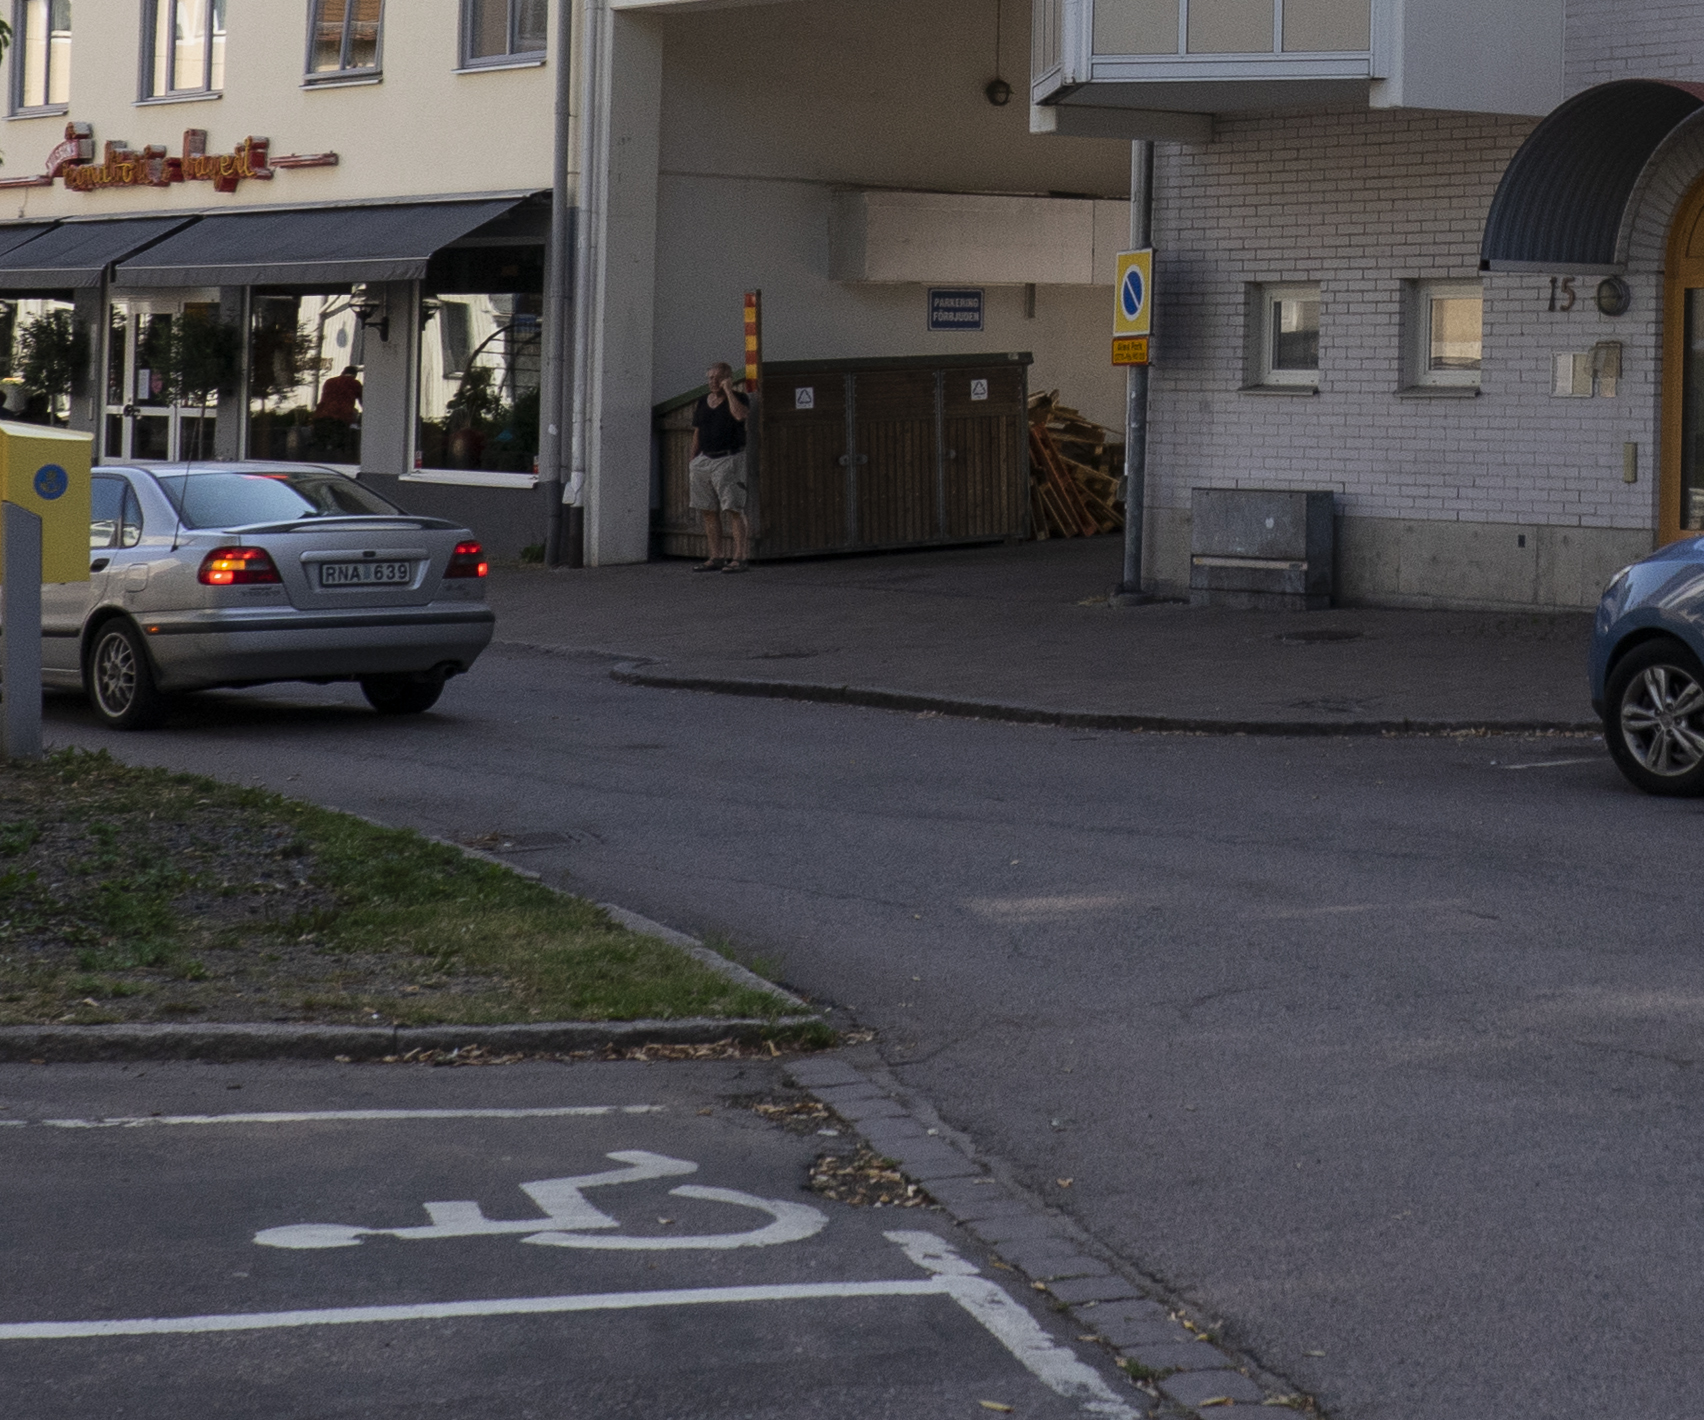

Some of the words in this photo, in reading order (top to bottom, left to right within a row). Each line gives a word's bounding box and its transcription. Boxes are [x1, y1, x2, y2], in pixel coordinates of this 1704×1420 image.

[1548, 276, 1576, 312] 15
[934, 297, 979, 308] PARKERING
[933, 309, 980, 322] FÖRBJUDEN
[324, 566, 361, 583] RNA
[374, 564, 408, 581] 639
